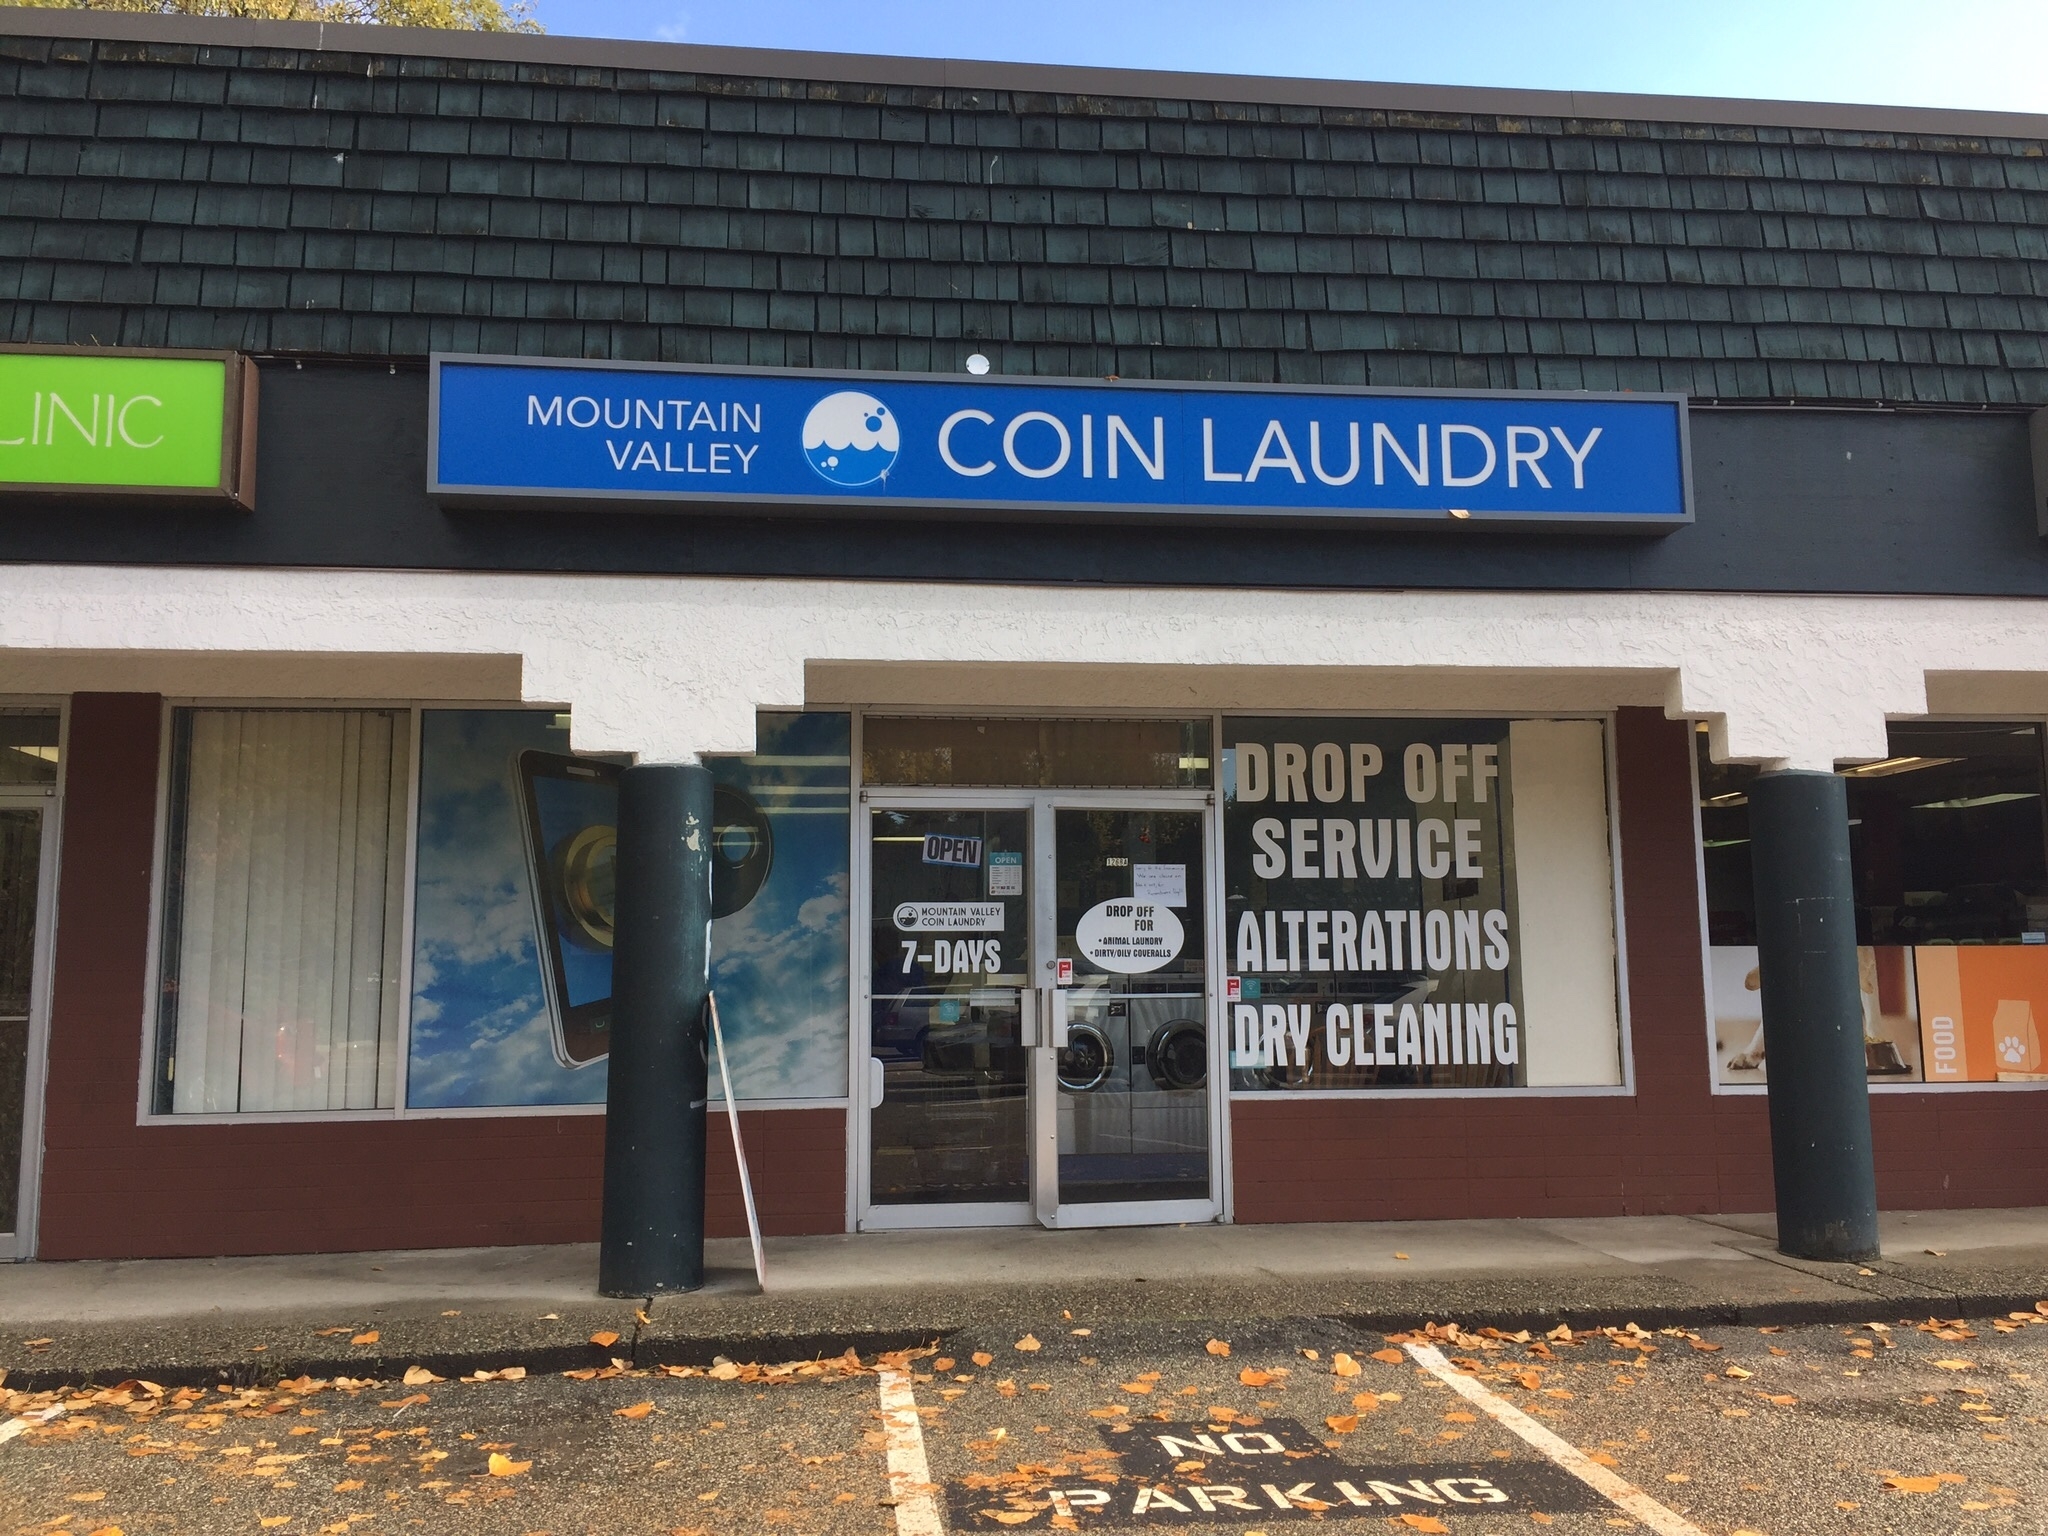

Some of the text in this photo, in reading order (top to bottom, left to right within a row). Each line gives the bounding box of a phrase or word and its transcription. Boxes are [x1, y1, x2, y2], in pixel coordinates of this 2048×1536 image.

[527, 395, 761, 433] MOUNTAIN
[606, 439, 759, 474] VALLEY
[938, 408, 1603, 489] COIN LAUNDRY
[1235, 742, 1498, 803] DROP OFF
[926, 835, 978, 864] OPEN
[994, 856, 1017, 864] OPEN
[1252, 817, 1484, 880] SERVICE
[921, 907, 1001, 916] MOUNTAIN VALLEY
[921, 918, 986, 926] COIN LAUNDRY
[1106, 905, 1154, 917] DROP OFF
[1134, 919, 1154, 931] FOR
[901, 939, 1001, 974] 7-DAYS
[1094, 949, 1171, 958] DIRTY/OILY COVERALLS
[1103, 937, 1163, 945] ANIMAL LAUNDRY
[1236, 909, 1510, 972] ALTERATIONS
[1234, 1002, 1519, 1067] DRY CLEANING
[1931, 1016, 1958, 1073] FOOD
[1156, 1432, 1286, 1458] NO
[1049, 1478, 1510, 1517] PARKING
